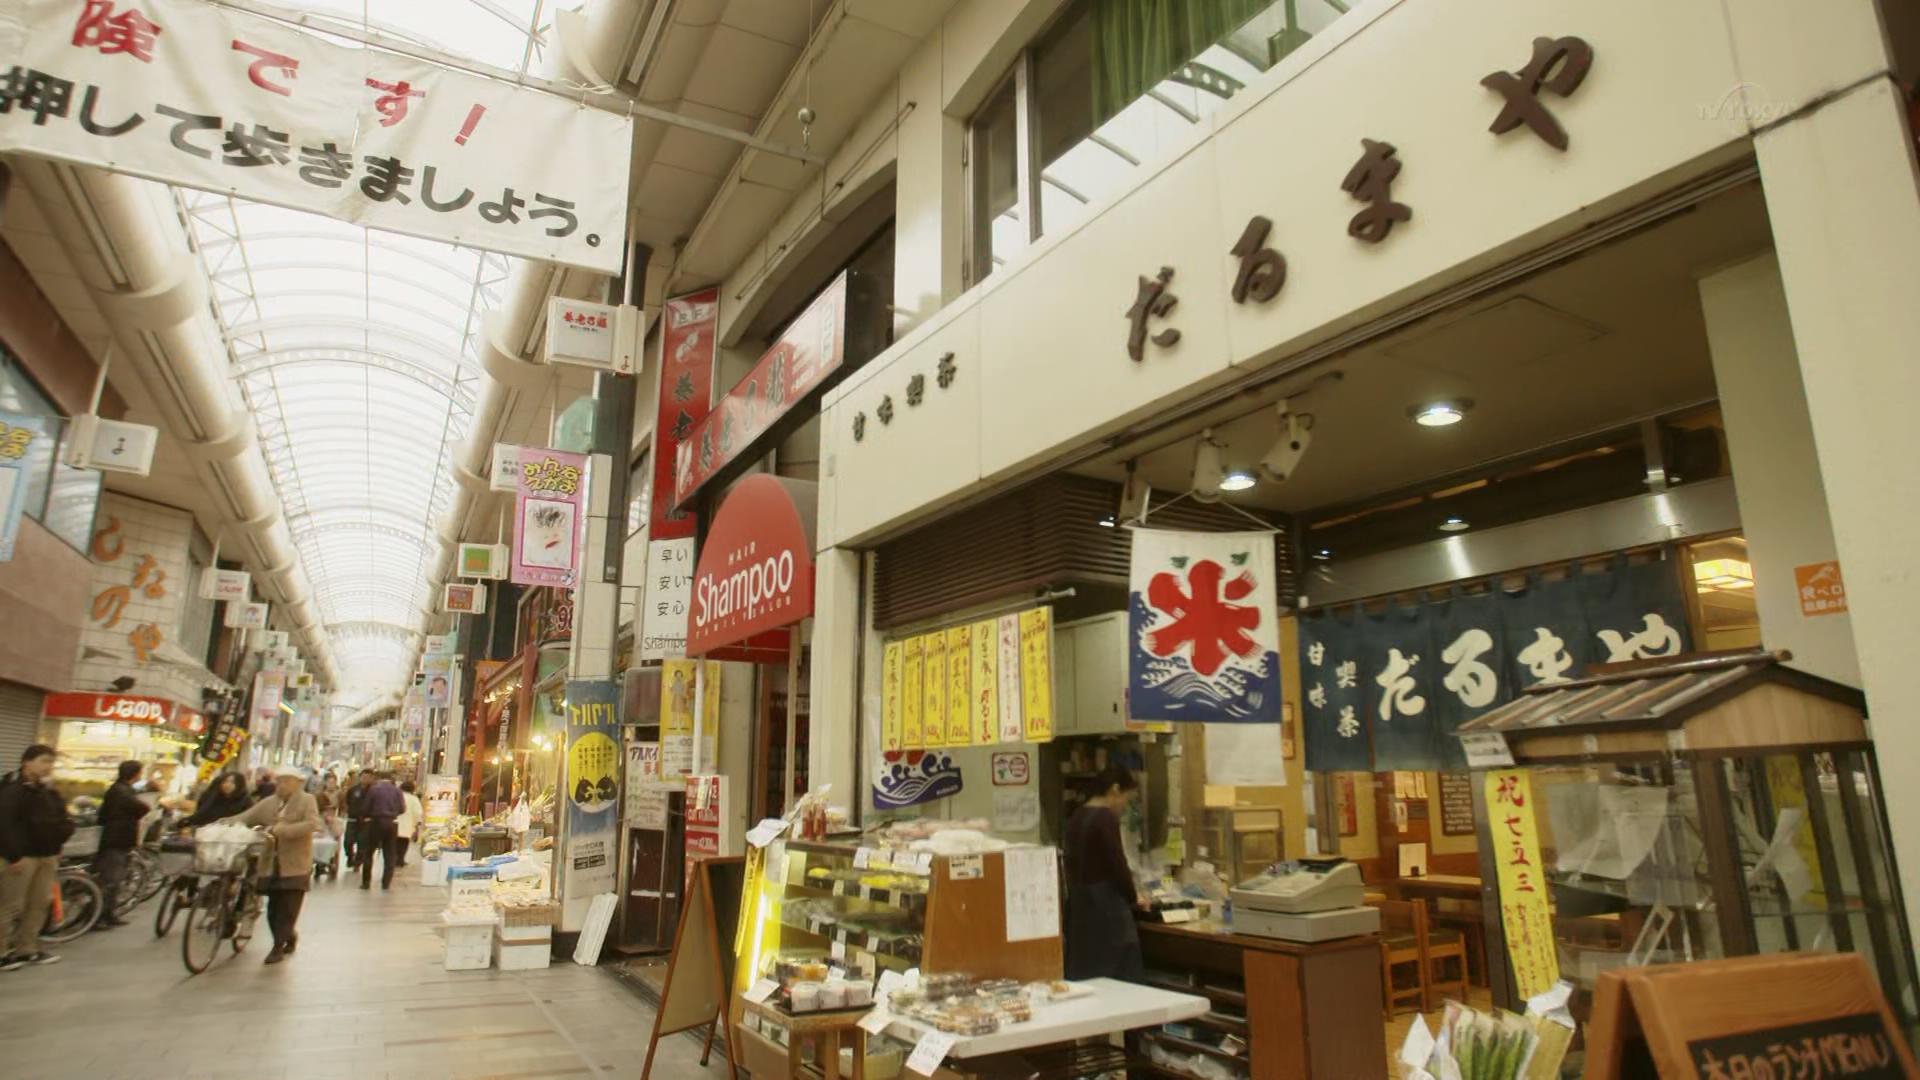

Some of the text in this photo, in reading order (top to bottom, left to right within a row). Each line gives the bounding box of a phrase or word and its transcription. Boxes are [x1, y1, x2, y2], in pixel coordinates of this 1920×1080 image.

[1126, 36, 1594, 362] だるまや
[661, 548, 688, 563] 早い
[659, 576, 687, 590] 安い
[695, 549, 794, 628] Shampoo
[656, 600, 685, 617] 安心
[1306, 641, 1328, 711] 甘味
